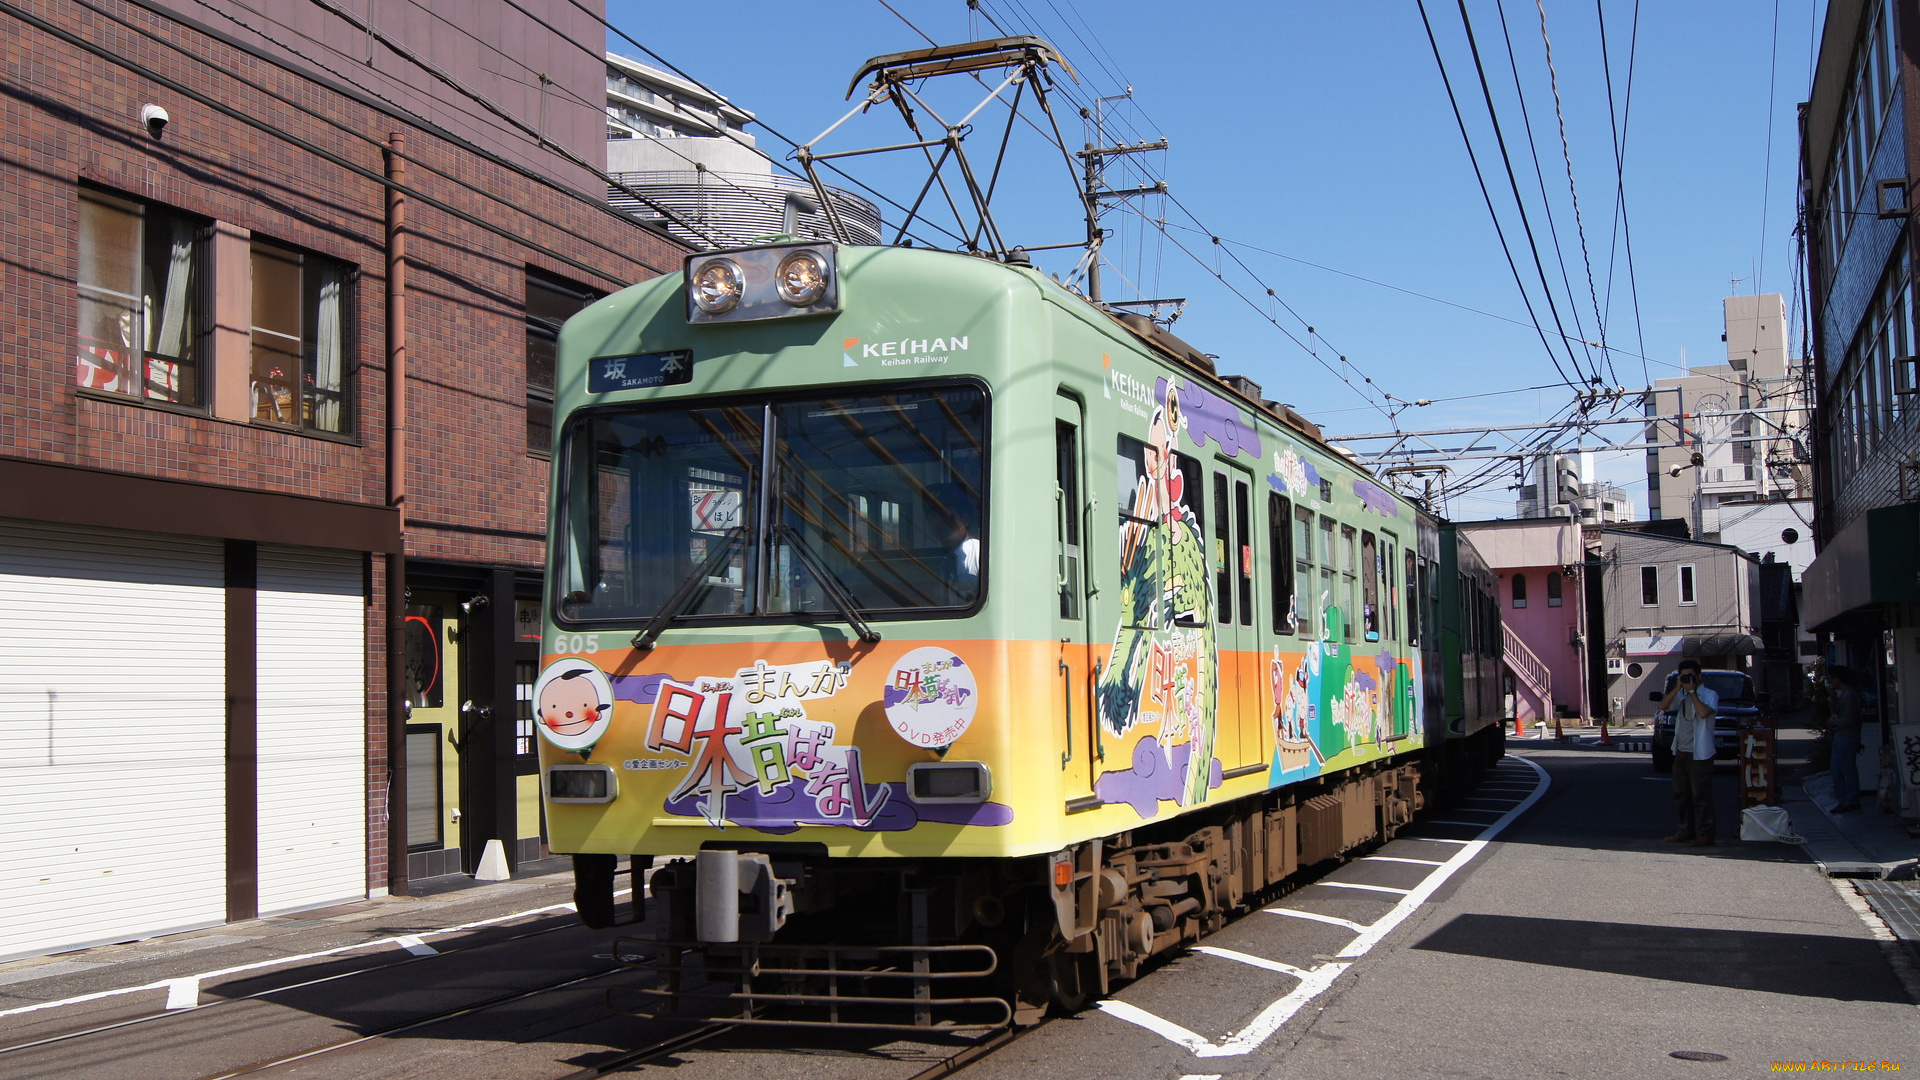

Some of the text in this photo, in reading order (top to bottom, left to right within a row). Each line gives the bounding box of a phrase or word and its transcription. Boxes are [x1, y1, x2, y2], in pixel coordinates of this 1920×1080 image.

[863, 336, 968, 357] KEIHAN
[881, 356, 949, 367] Keihan Railway
[622, 376, 664, 387] SAKAMOTO
[1111, 369, 1155, 408] KEIHAN
[714, 511, 734, 522] ほし
[554, 634, 599, 654] 605
[921, 661, 953, 675] まんが
[740, 664, 849, 703] まんが
